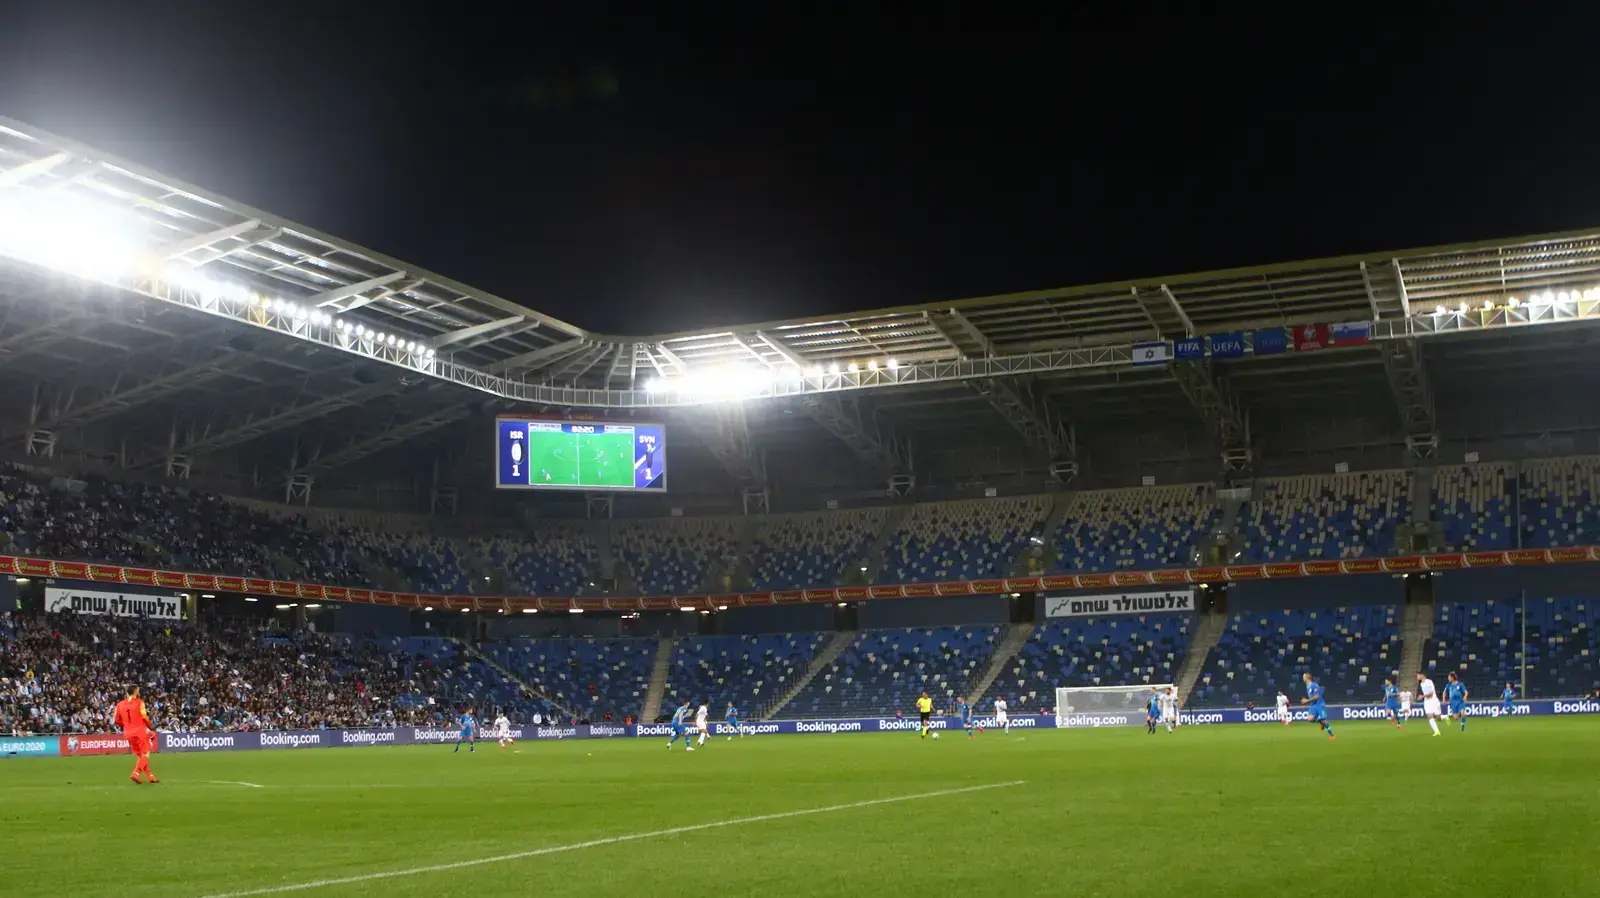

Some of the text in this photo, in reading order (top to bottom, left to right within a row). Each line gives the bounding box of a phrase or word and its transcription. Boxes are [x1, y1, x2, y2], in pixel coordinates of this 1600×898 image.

[1178, 342, 1200, 352] FIFA
[1213, 341, 1241, 352] UEFA
[510, 431, 524, 439] ISR
[639, 435, 656, 444] SVN
[512, 464, 521, 476] 1
[645, 468, 653, 480] 1
[19, 560, 47, 571] Winner
[91, 567, 117, 578] Winner
[126, 569, 150, 580] Winner
[71, 594, 177, 616] אלטשולר שחם
[1071, 593, 1189, 613] אלטשולר שחם
[1447, 703, 1530, 717] Boking.com
[1553, 700, 1600, 713] Bookin
[126, 709, 132, 724] 1
[1244, 709, 1309, 722] Bookig.co
[796, 721, 861, 732] Booking.com
[879, 719, 947, 730] Booking.om
[971, 717, 1036, 728] ooki.com
[480, 728, 522, 738] Bookicom
[538, 726, 576, 738] Booking.com
[590, 724, 625, 736] Booking.com
[637, 725, 699, 736] Bookingom
[716, 723, 779, 735] Booing.com
[166, 735, 234, 750] Booking.com
[260, 732, 320, 747] Booking.com
[343, 731, 395, 744] Booking.com
[2, 741, 46, 751] EURO 2020
[81, 739, 117, 749] EUROPEAN
